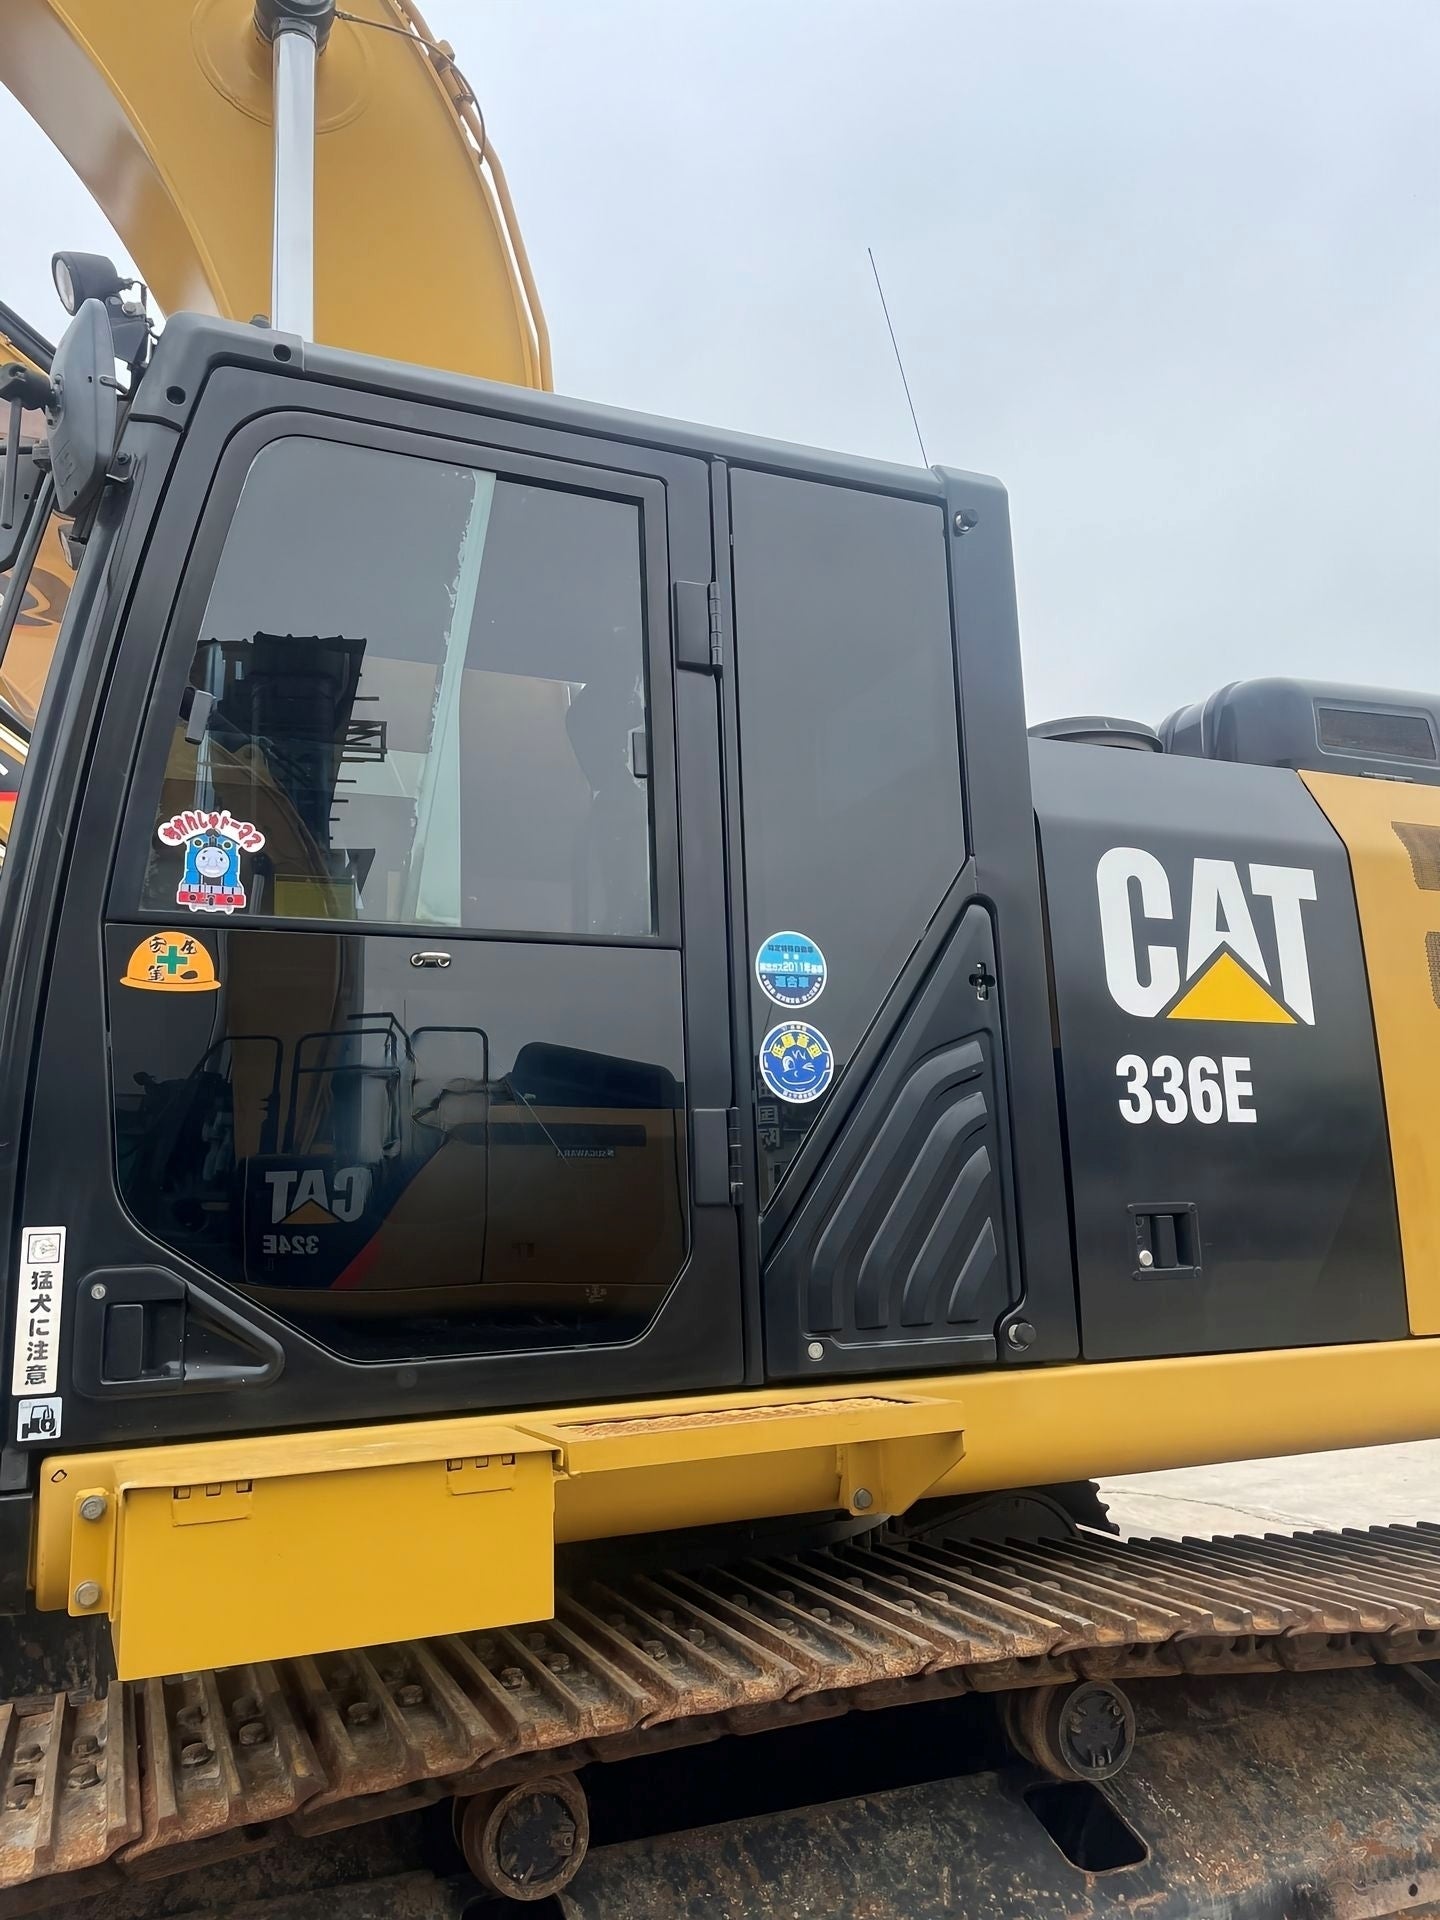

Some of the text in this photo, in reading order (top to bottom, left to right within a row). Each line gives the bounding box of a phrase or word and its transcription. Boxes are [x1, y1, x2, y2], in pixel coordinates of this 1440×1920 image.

[1096, 846, 1318, 1026] CAT
[1115, 1054, 1258, 1125] 336E
[25, 1270, 54, 1385] 猛犬に注意
